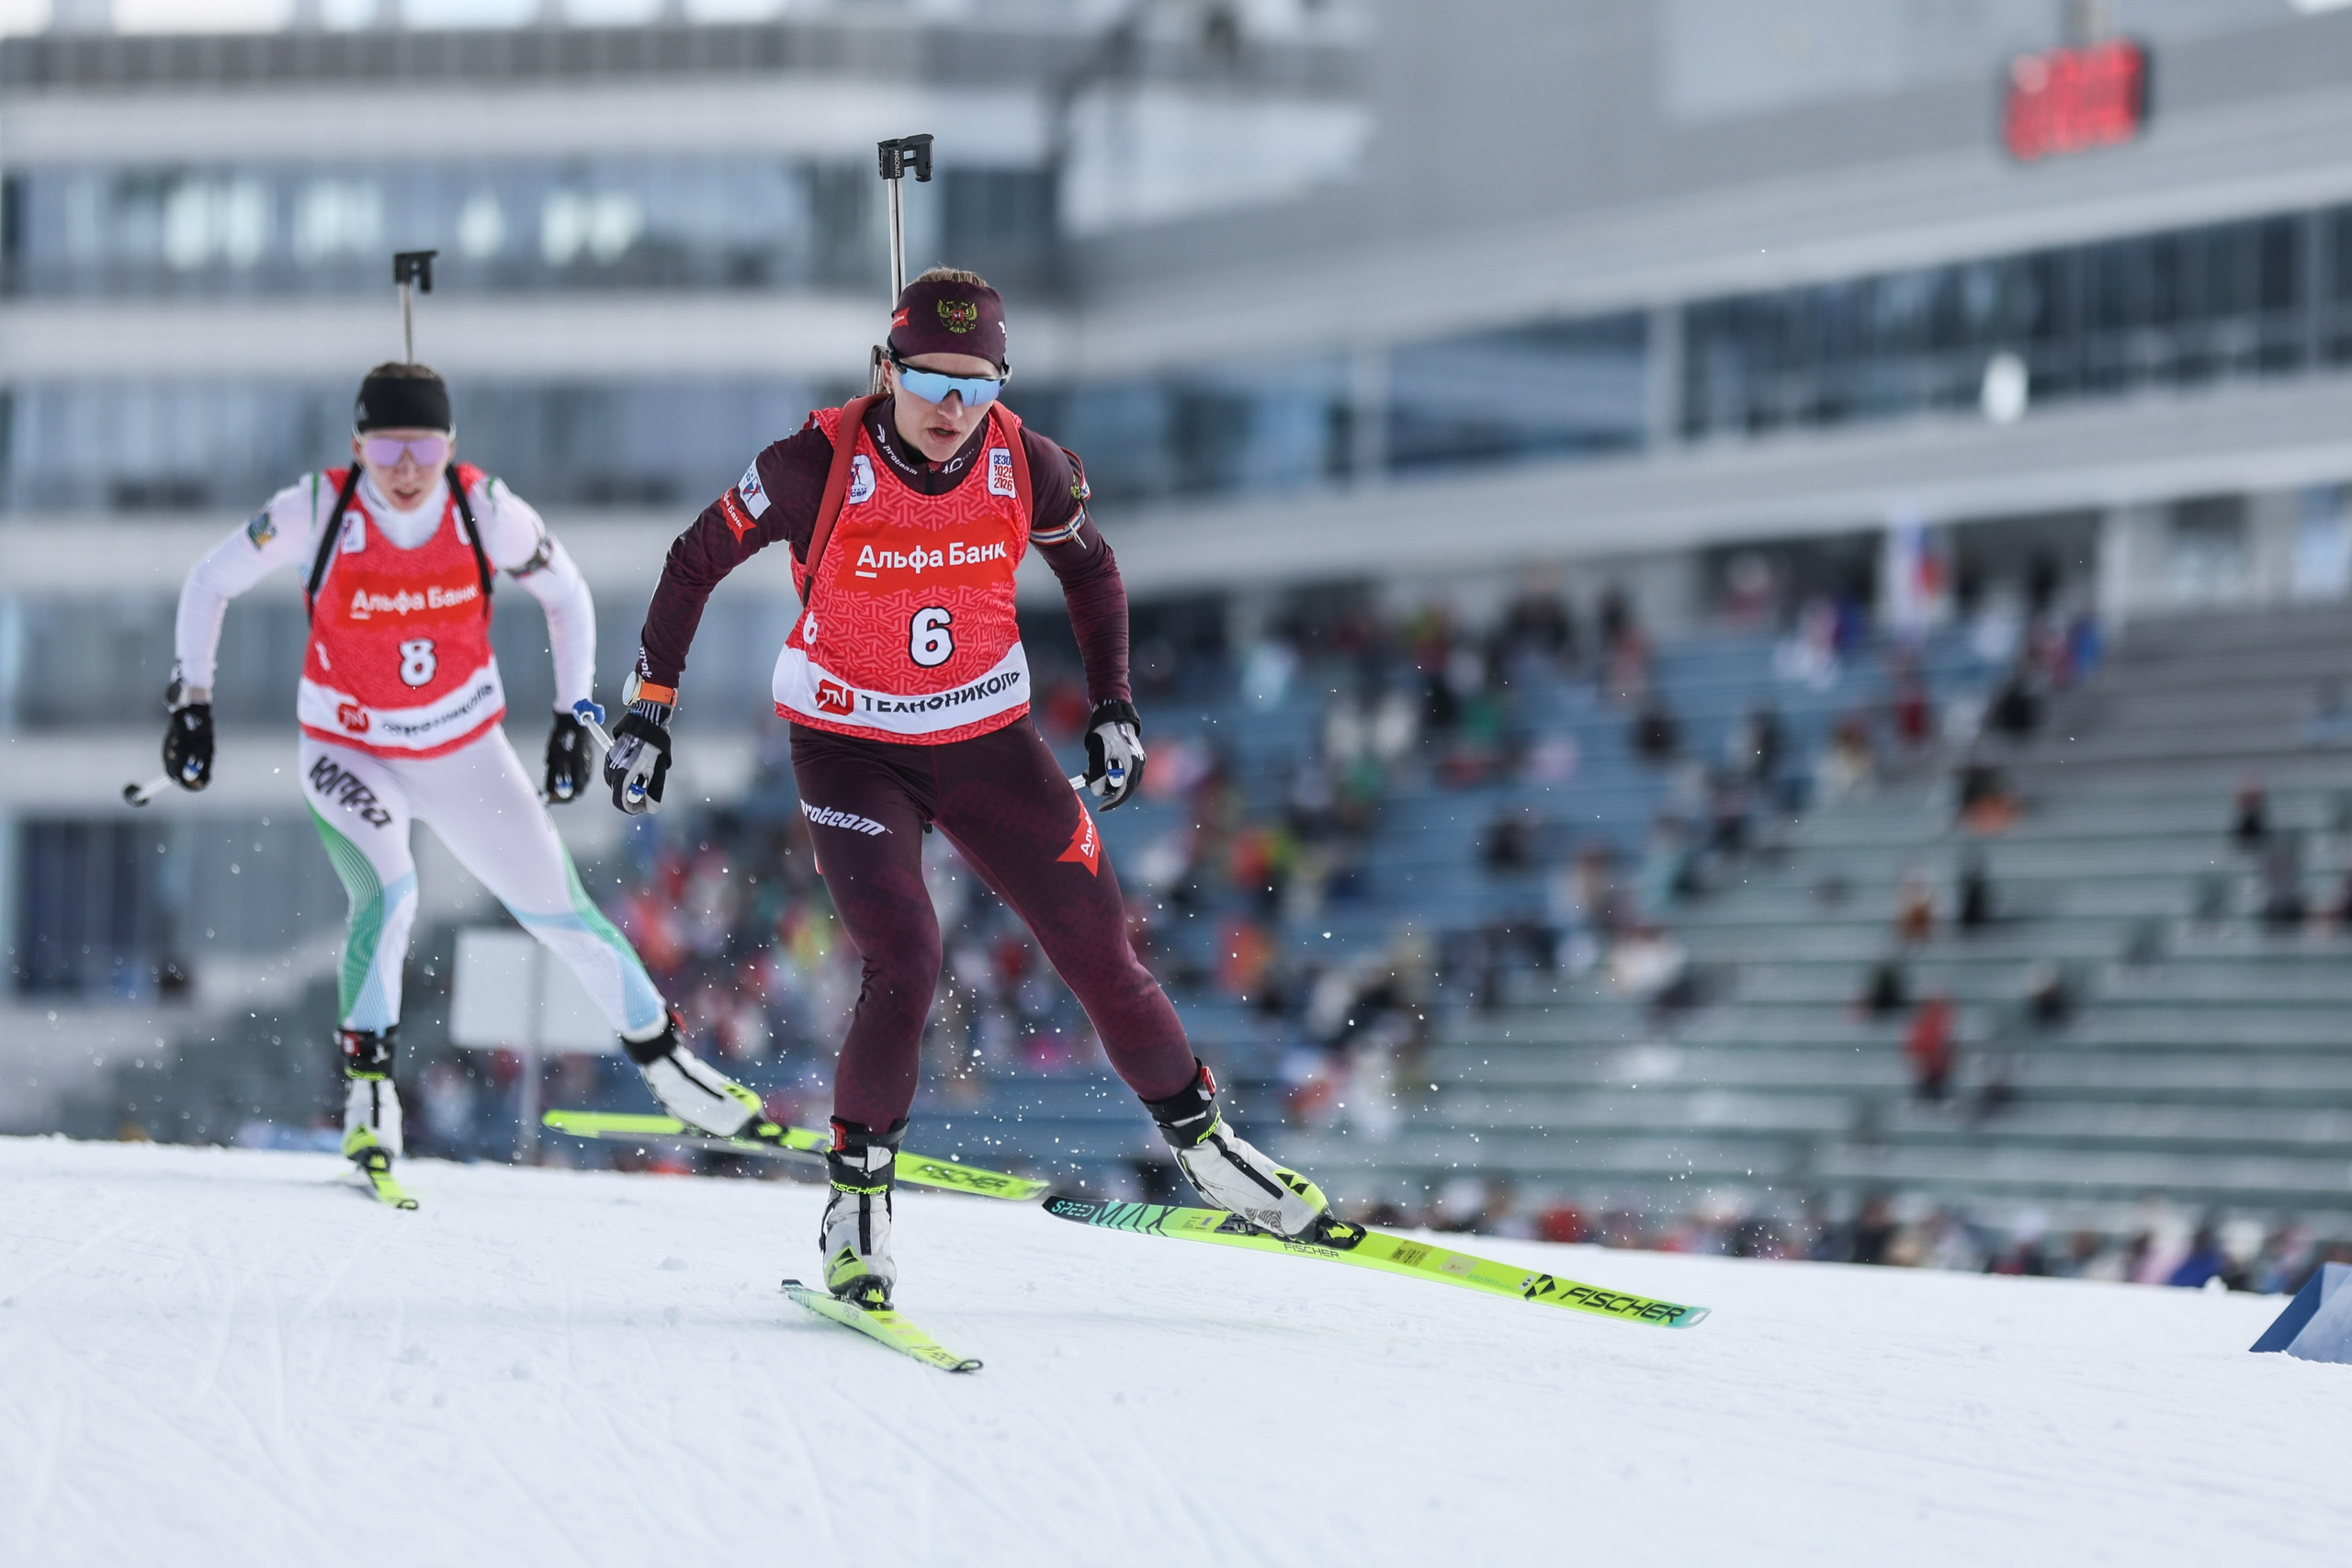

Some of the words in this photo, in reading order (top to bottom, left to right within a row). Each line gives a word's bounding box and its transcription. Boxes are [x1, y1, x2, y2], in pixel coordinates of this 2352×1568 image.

[994, 455, 1012, 466] СЕЗО
[994, 478, 1013, 491] 2026
[855, 545, 944, 579] Альфа
[949, 541, 1007, 566] Банк
[350, 588, 425, 620] Альфа
[910, 606, 955, 668] 6
[399, 637, 437, 687] 8
[862, 671, 1020, 713] ТЕХНОНИКОЛЬ
[831, 1179, 888, 1195] FISCHER
[913, 1164, 1010, 1191] FISCHER
[1051, 1200, 1096, 1217] SPEED
[1283, 1243, 1341, 1259] FISCHER
[1558, 1287, 1687, 1324] FISCHER
